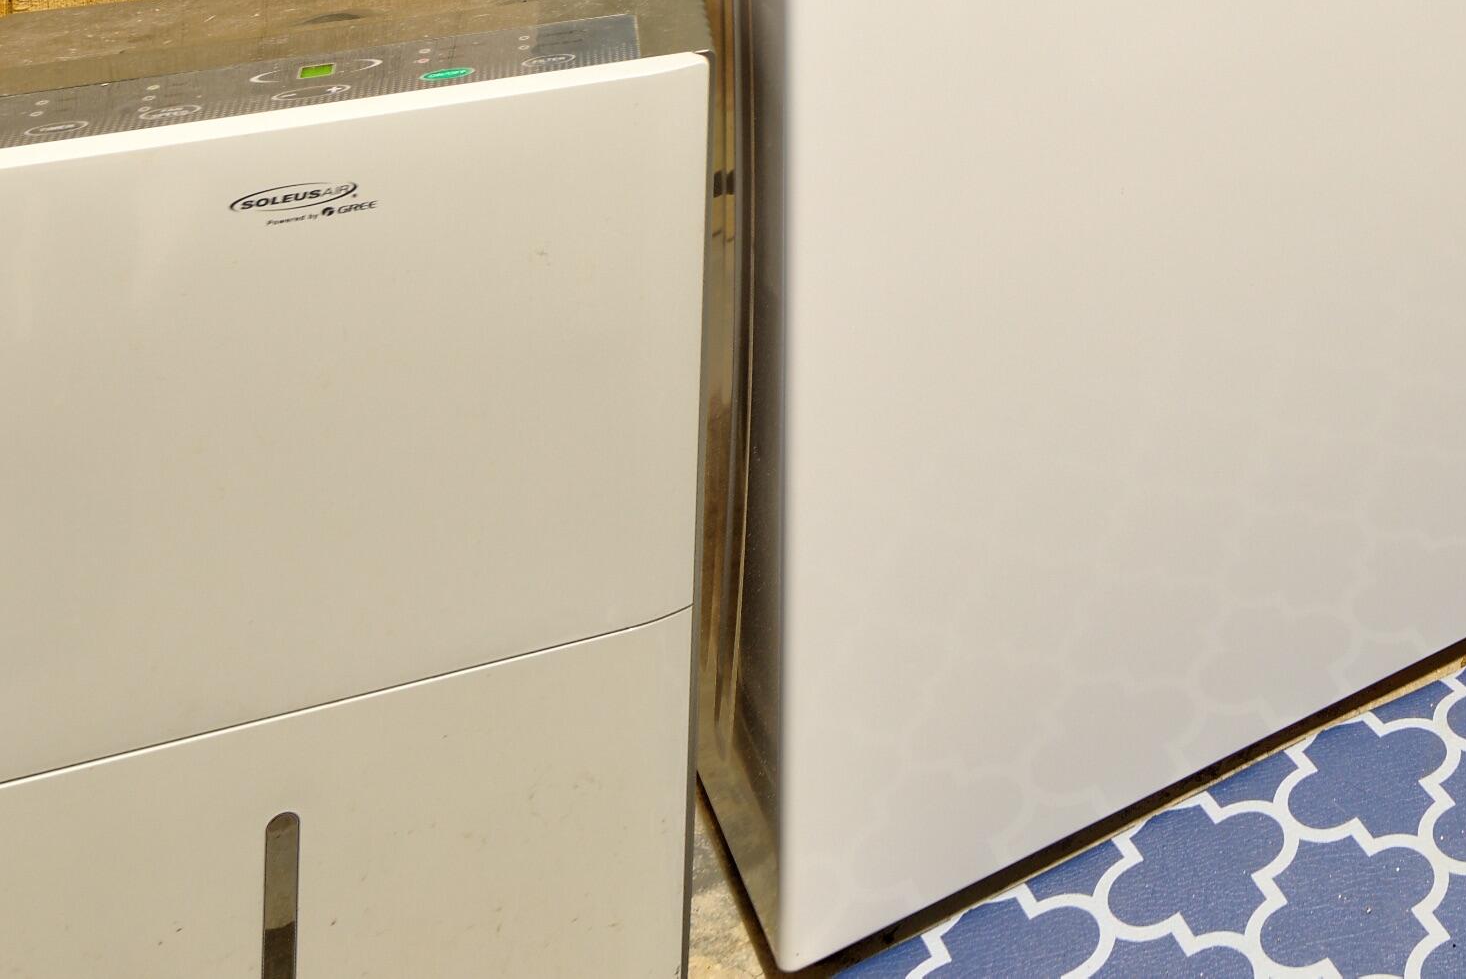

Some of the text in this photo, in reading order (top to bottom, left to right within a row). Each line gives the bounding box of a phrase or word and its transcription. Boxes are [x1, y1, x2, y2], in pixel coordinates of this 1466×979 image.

[240, 184, 350, 210] SOLEUSAIR
[266, 200, 377, 226] Powered by GREE
